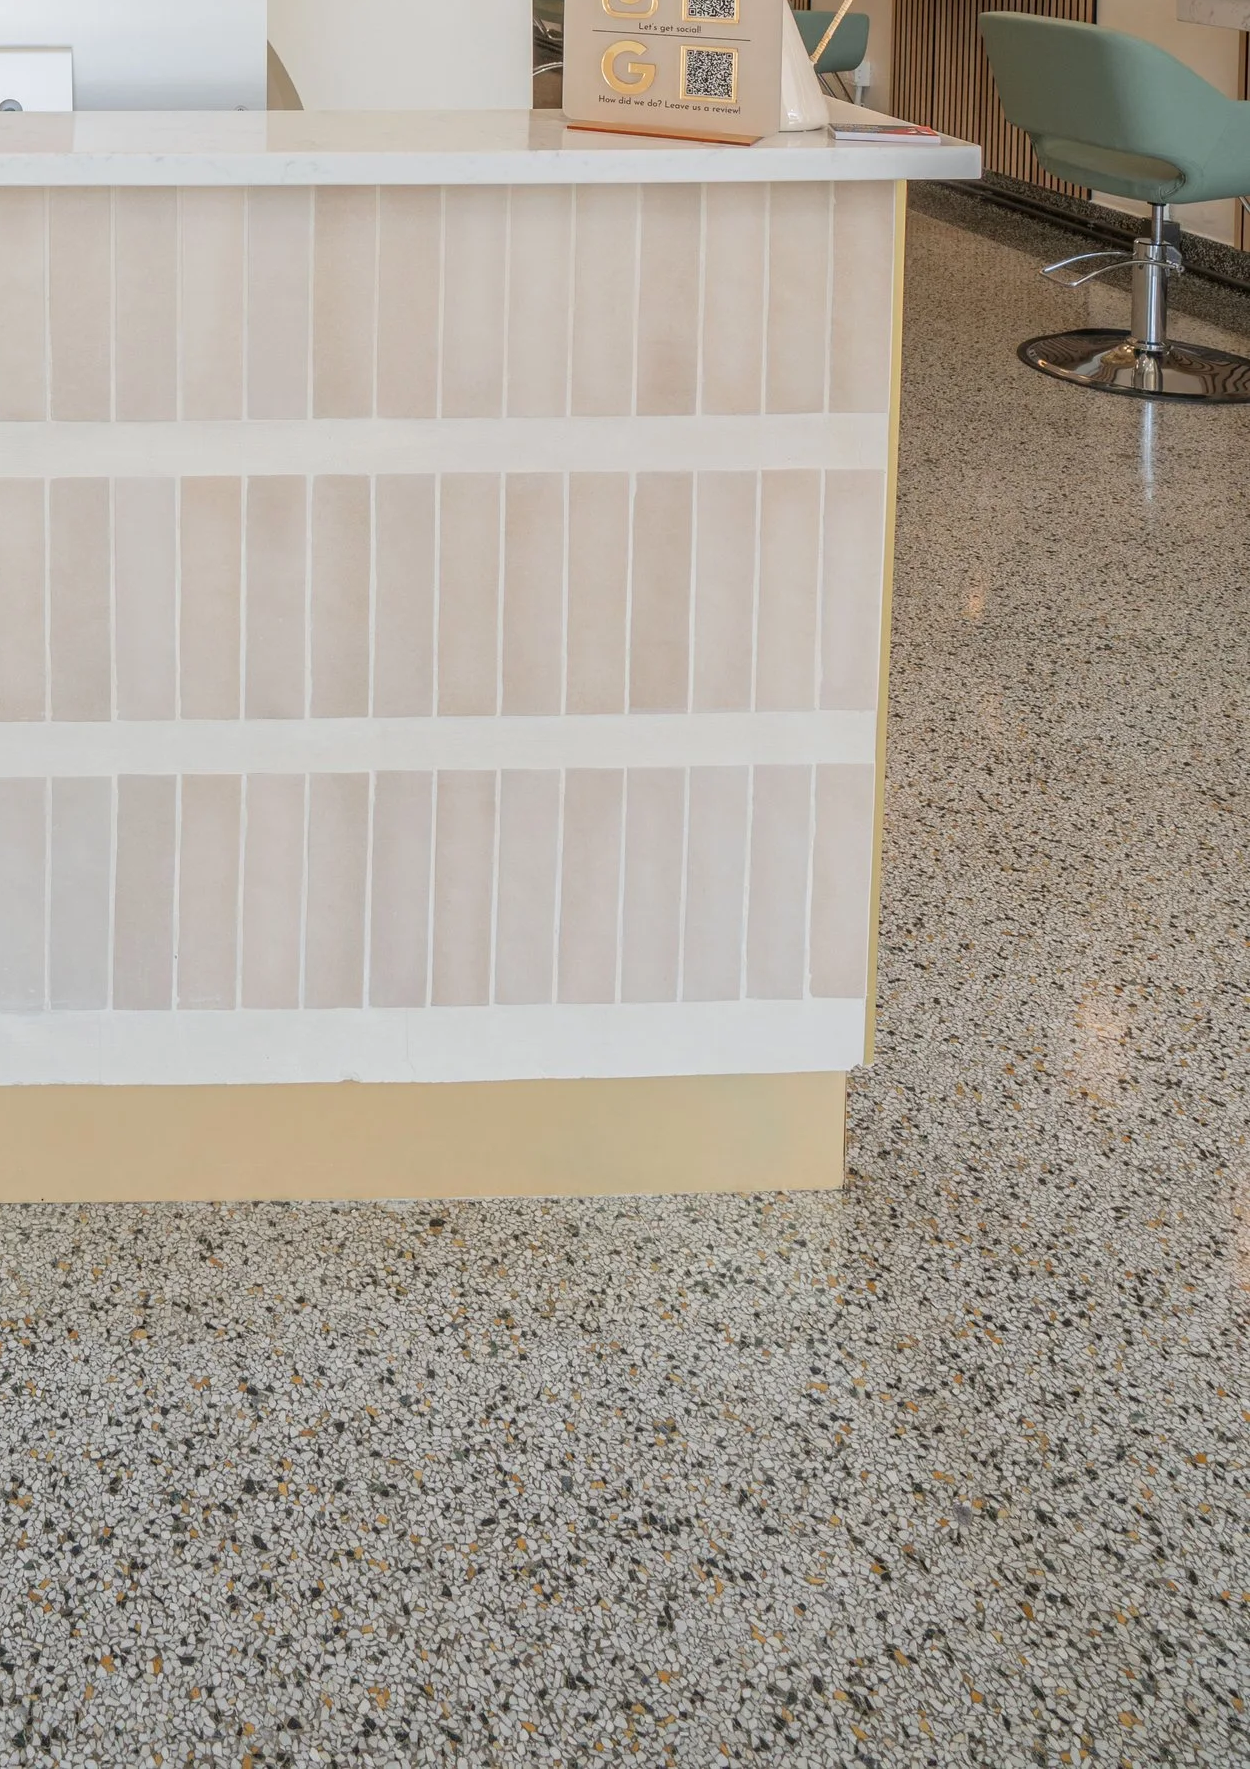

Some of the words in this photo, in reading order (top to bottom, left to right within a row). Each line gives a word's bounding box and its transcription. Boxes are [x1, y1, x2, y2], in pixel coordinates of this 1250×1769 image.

[638, 22, 658, 31] Let's
[660, 25, 673, 33] get
[676, 26, 702, 34] social!
[598, 94, 616, 103] How
[618, 96, 632, 105] did
[647, 99, 662, 108] do?
[664, 101, 690, 111] Leave
[712, 106, 741, 114] review!
